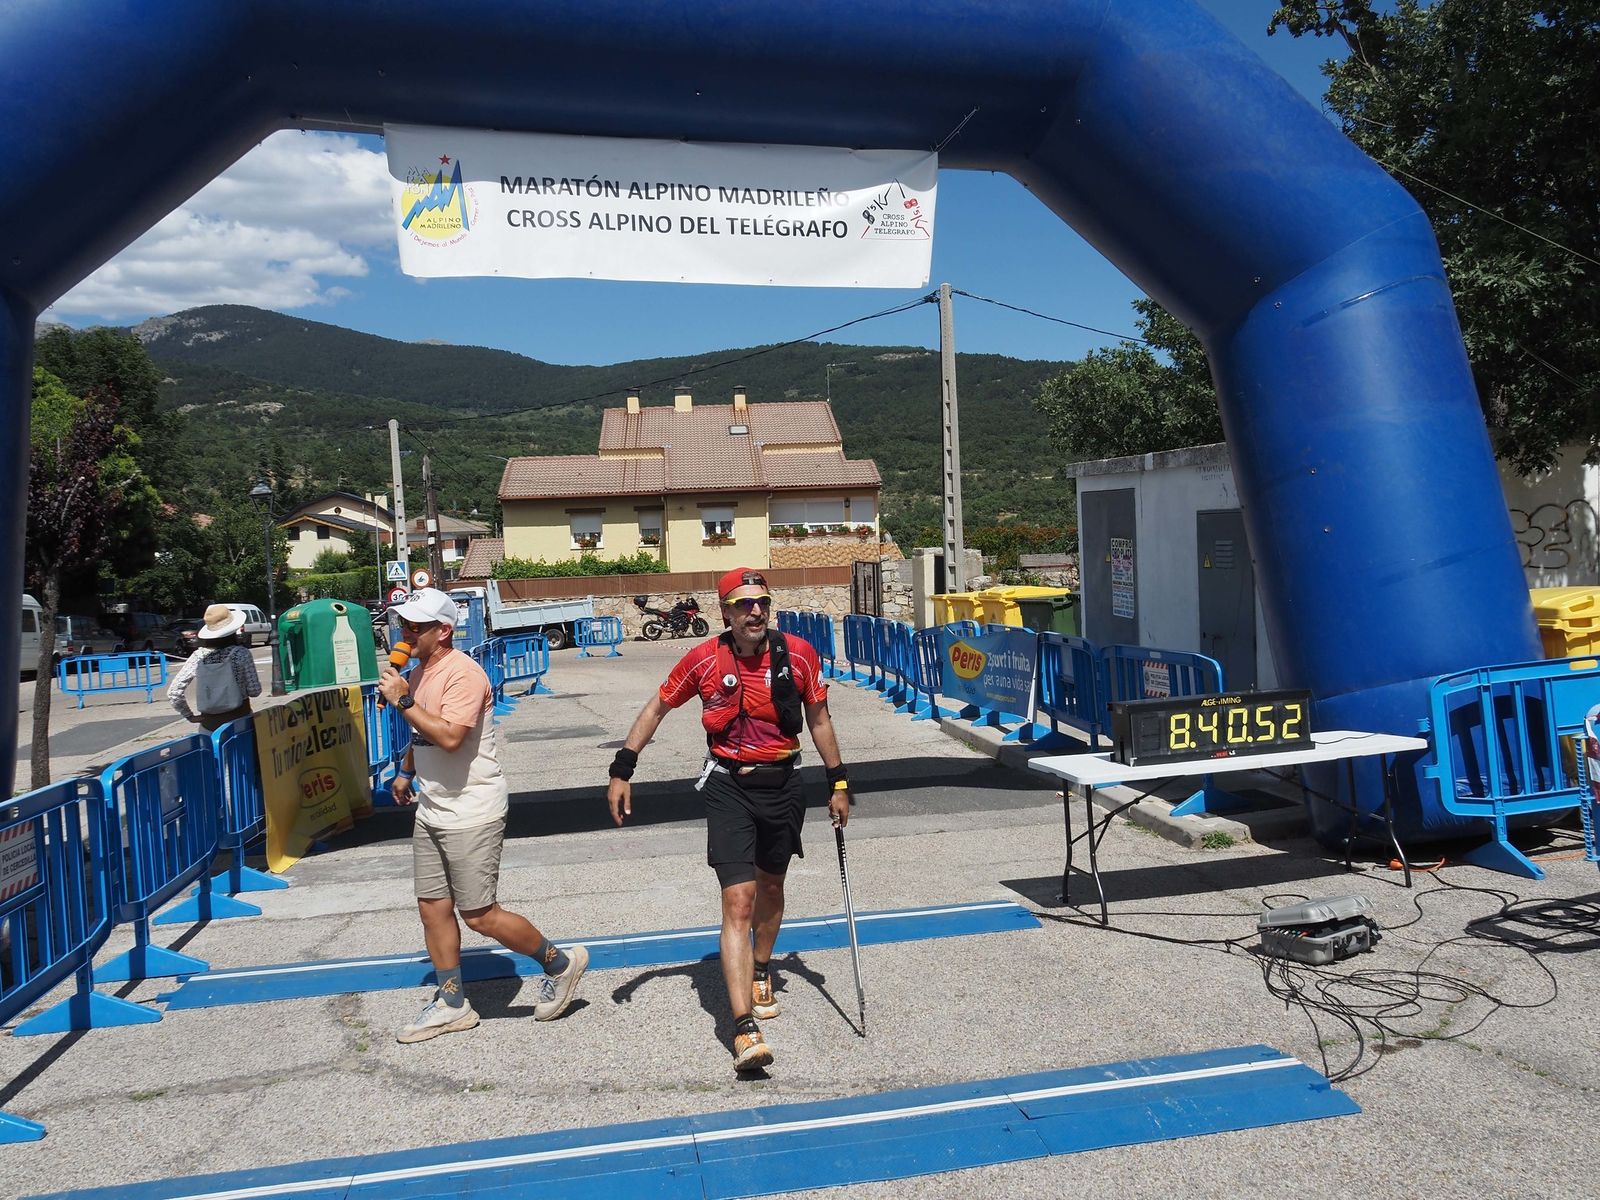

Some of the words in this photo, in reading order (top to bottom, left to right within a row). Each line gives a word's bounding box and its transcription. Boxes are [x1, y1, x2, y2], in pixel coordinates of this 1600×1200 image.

[500, 174, 620, 198] MARATÓN
[628, 181, 711, 202] ALPINO
[718, 186, 849, 208] MADRILEÑO
[507, 209, 581, 228] CROSS
[588, 212, 672, 234] ALPINO
[680, 216, 720, 235] DEL
[726, 214, 848, 239] TELÉGRAFO
[882, 213, 905, 221] CROSS
[952, 646, 982, 672] Peris
[1169, 704, 1302, 750] 8.40.52
[302, 772, 336, 799] eris
